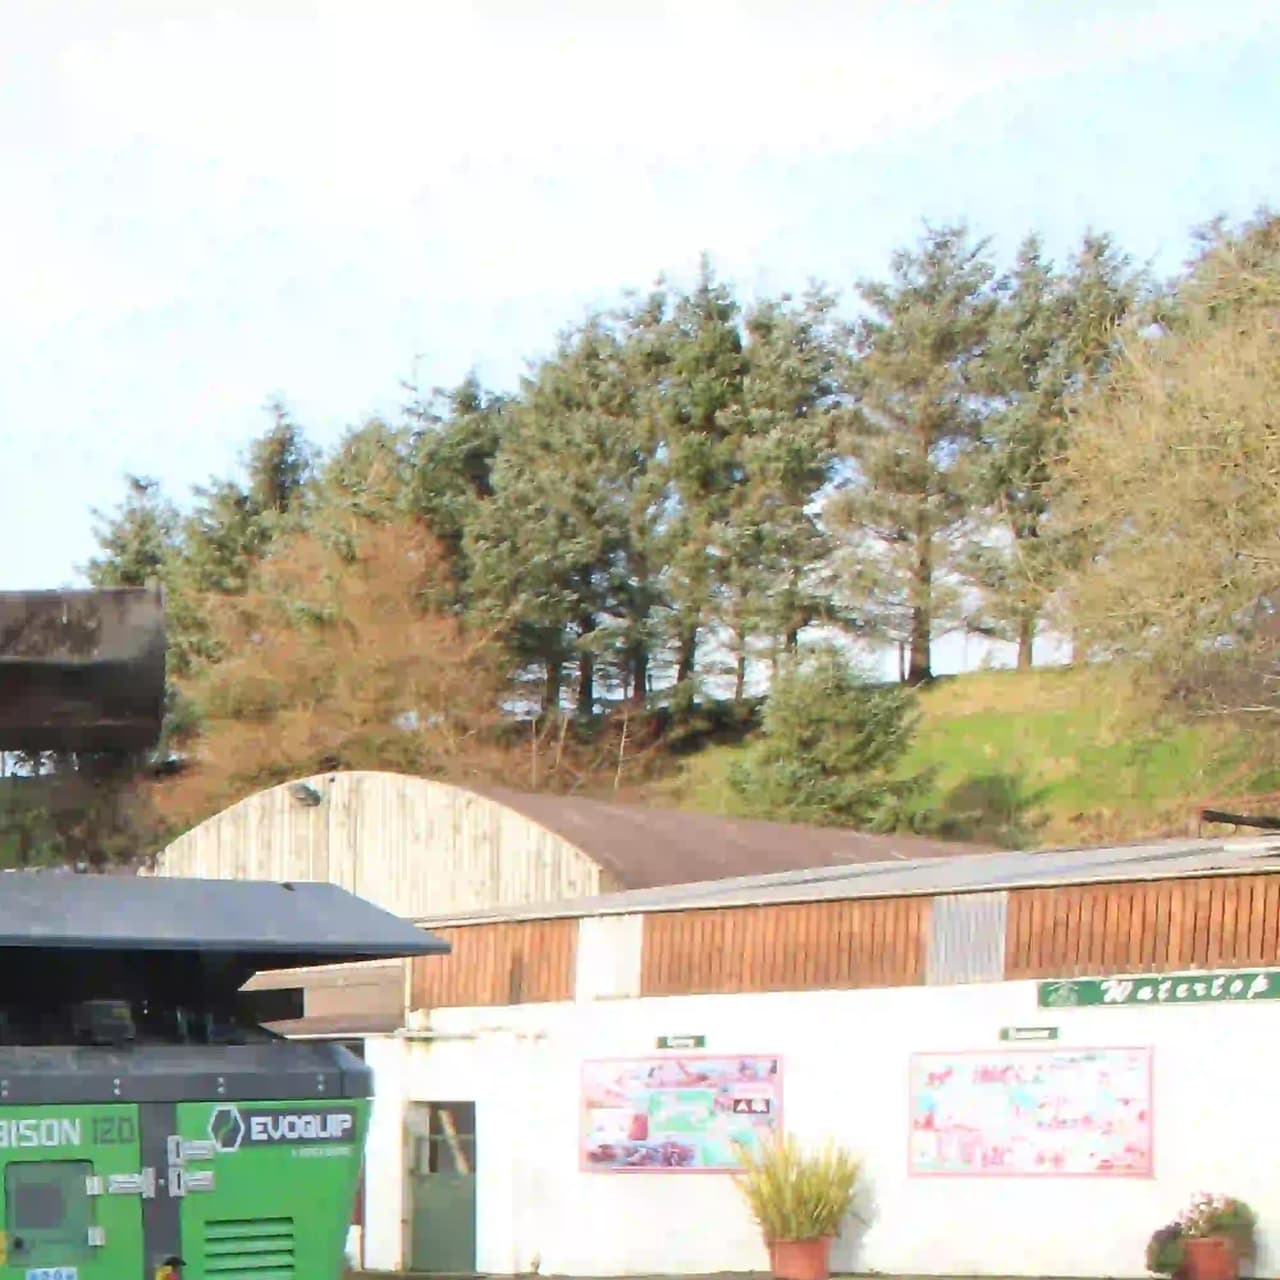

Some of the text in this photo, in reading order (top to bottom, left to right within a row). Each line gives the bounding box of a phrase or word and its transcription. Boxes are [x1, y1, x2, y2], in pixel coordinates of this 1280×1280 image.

[1100, 974, 1269, 1003] Watertop
[92, 1116, 135, 1145] 120
[250, 1114, 352, 1141] EVOQUIP
